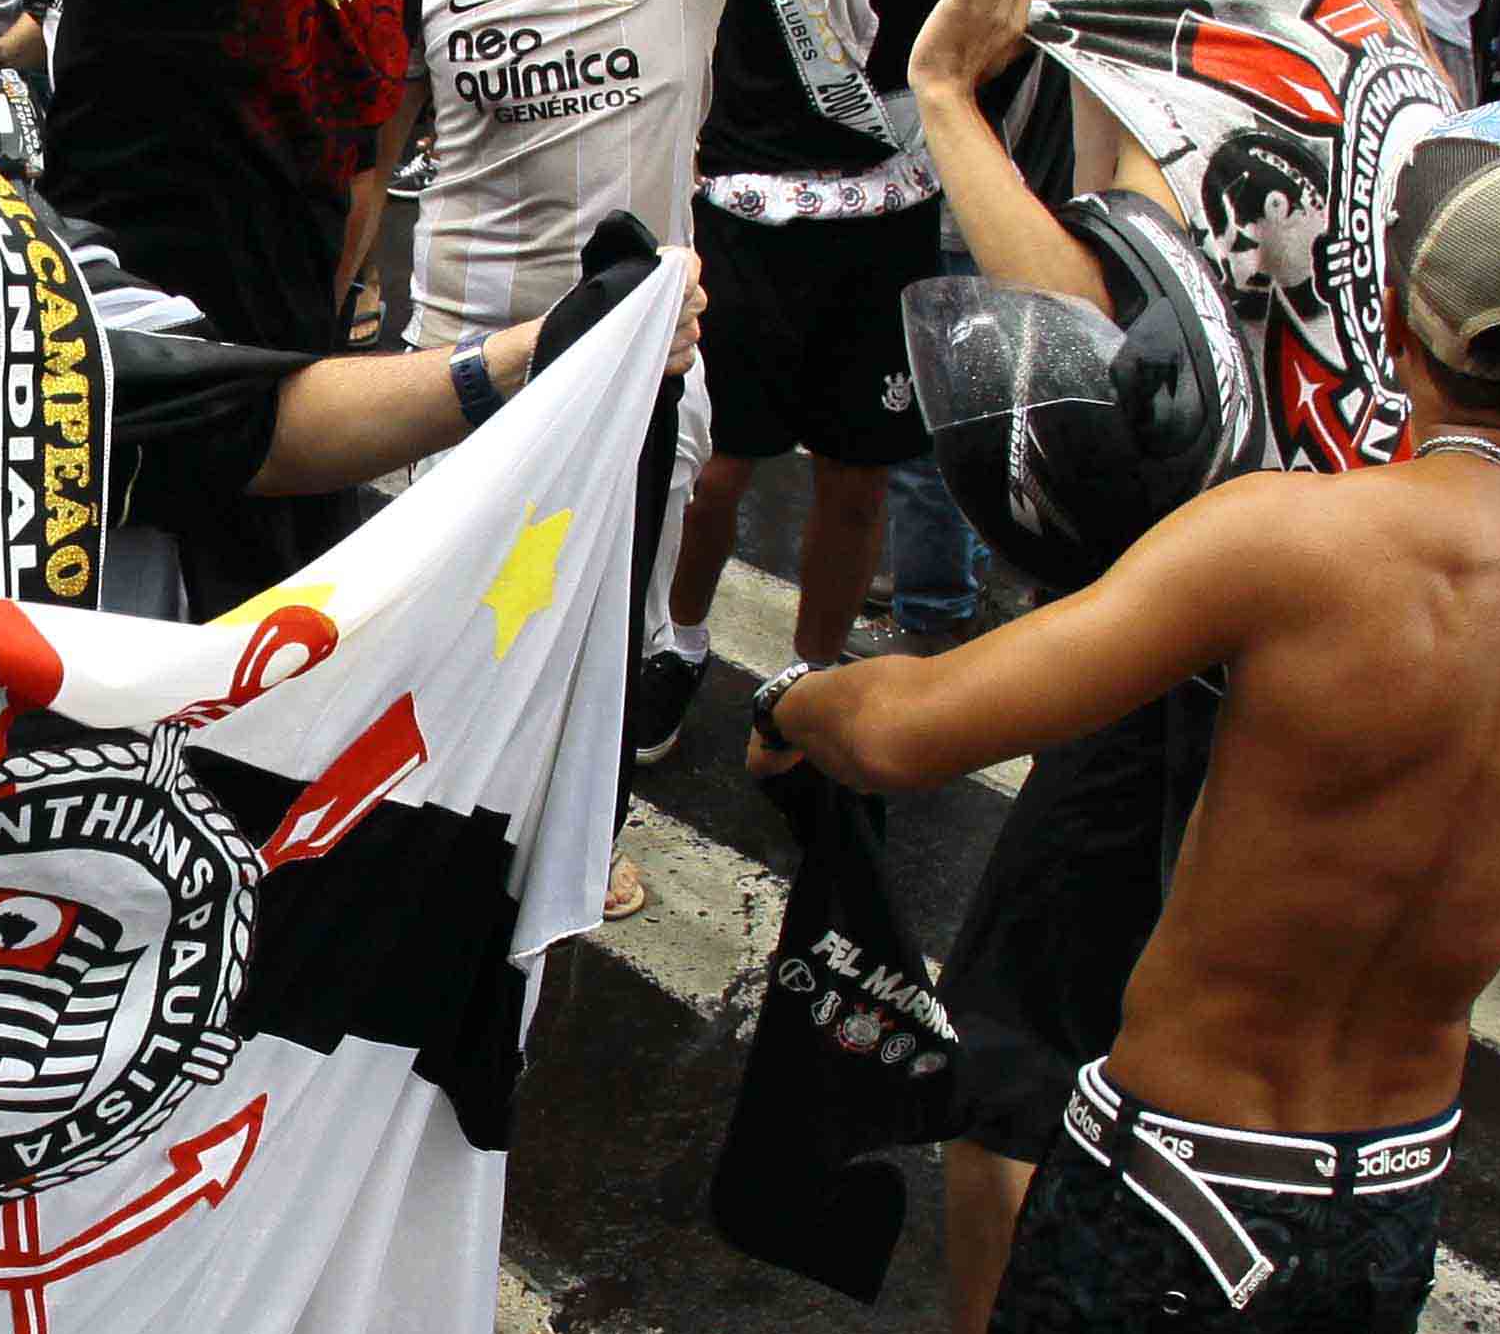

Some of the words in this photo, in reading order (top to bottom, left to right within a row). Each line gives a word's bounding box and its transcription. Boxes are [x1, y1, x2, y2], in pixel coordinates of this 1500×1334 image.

[447, 26, 542, 63] neo
[454, 46, 640, 116] química
[495, 85, 644, 124] GENÉRICOS
[13, 905, 213, 1168] PAULISTA
[1355, 1145, 1431, 1178] adidas
